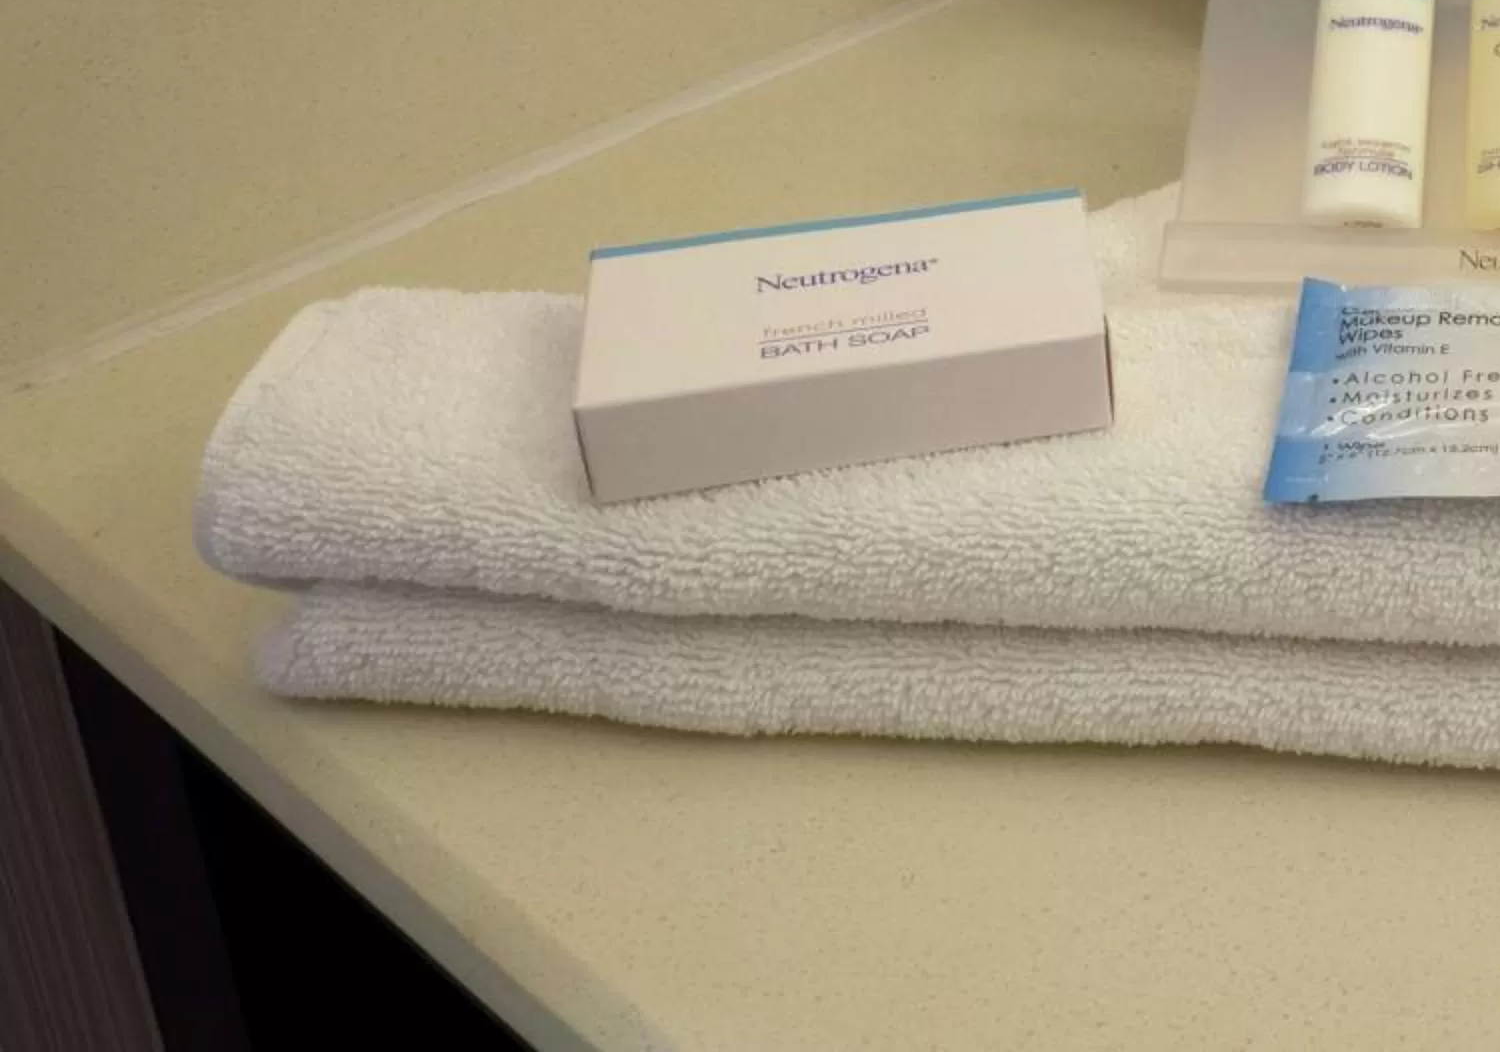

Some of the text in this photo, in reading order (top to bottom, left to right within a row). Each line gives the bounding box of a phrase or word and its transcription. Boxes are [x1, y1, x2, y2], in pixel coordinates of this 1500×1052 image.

[1313, 160, 1413, 180] BODY LOTION
[763, 308, 927, 338] french milled
[1341, 311, 1431, 328] Makeup
[760, 325, 930, 359] BATH SOAP
[1338, 326, 1404, 345] Wipes
[1372, 342, 1436, 356] Vitamin
[1440, 343, 1450, 355] E
[1343, 369, 1449, 385] Alcohol
[1341, 388, 1494, 405] Moisturizes
[1340, 405, 1490, 425] Conditions
